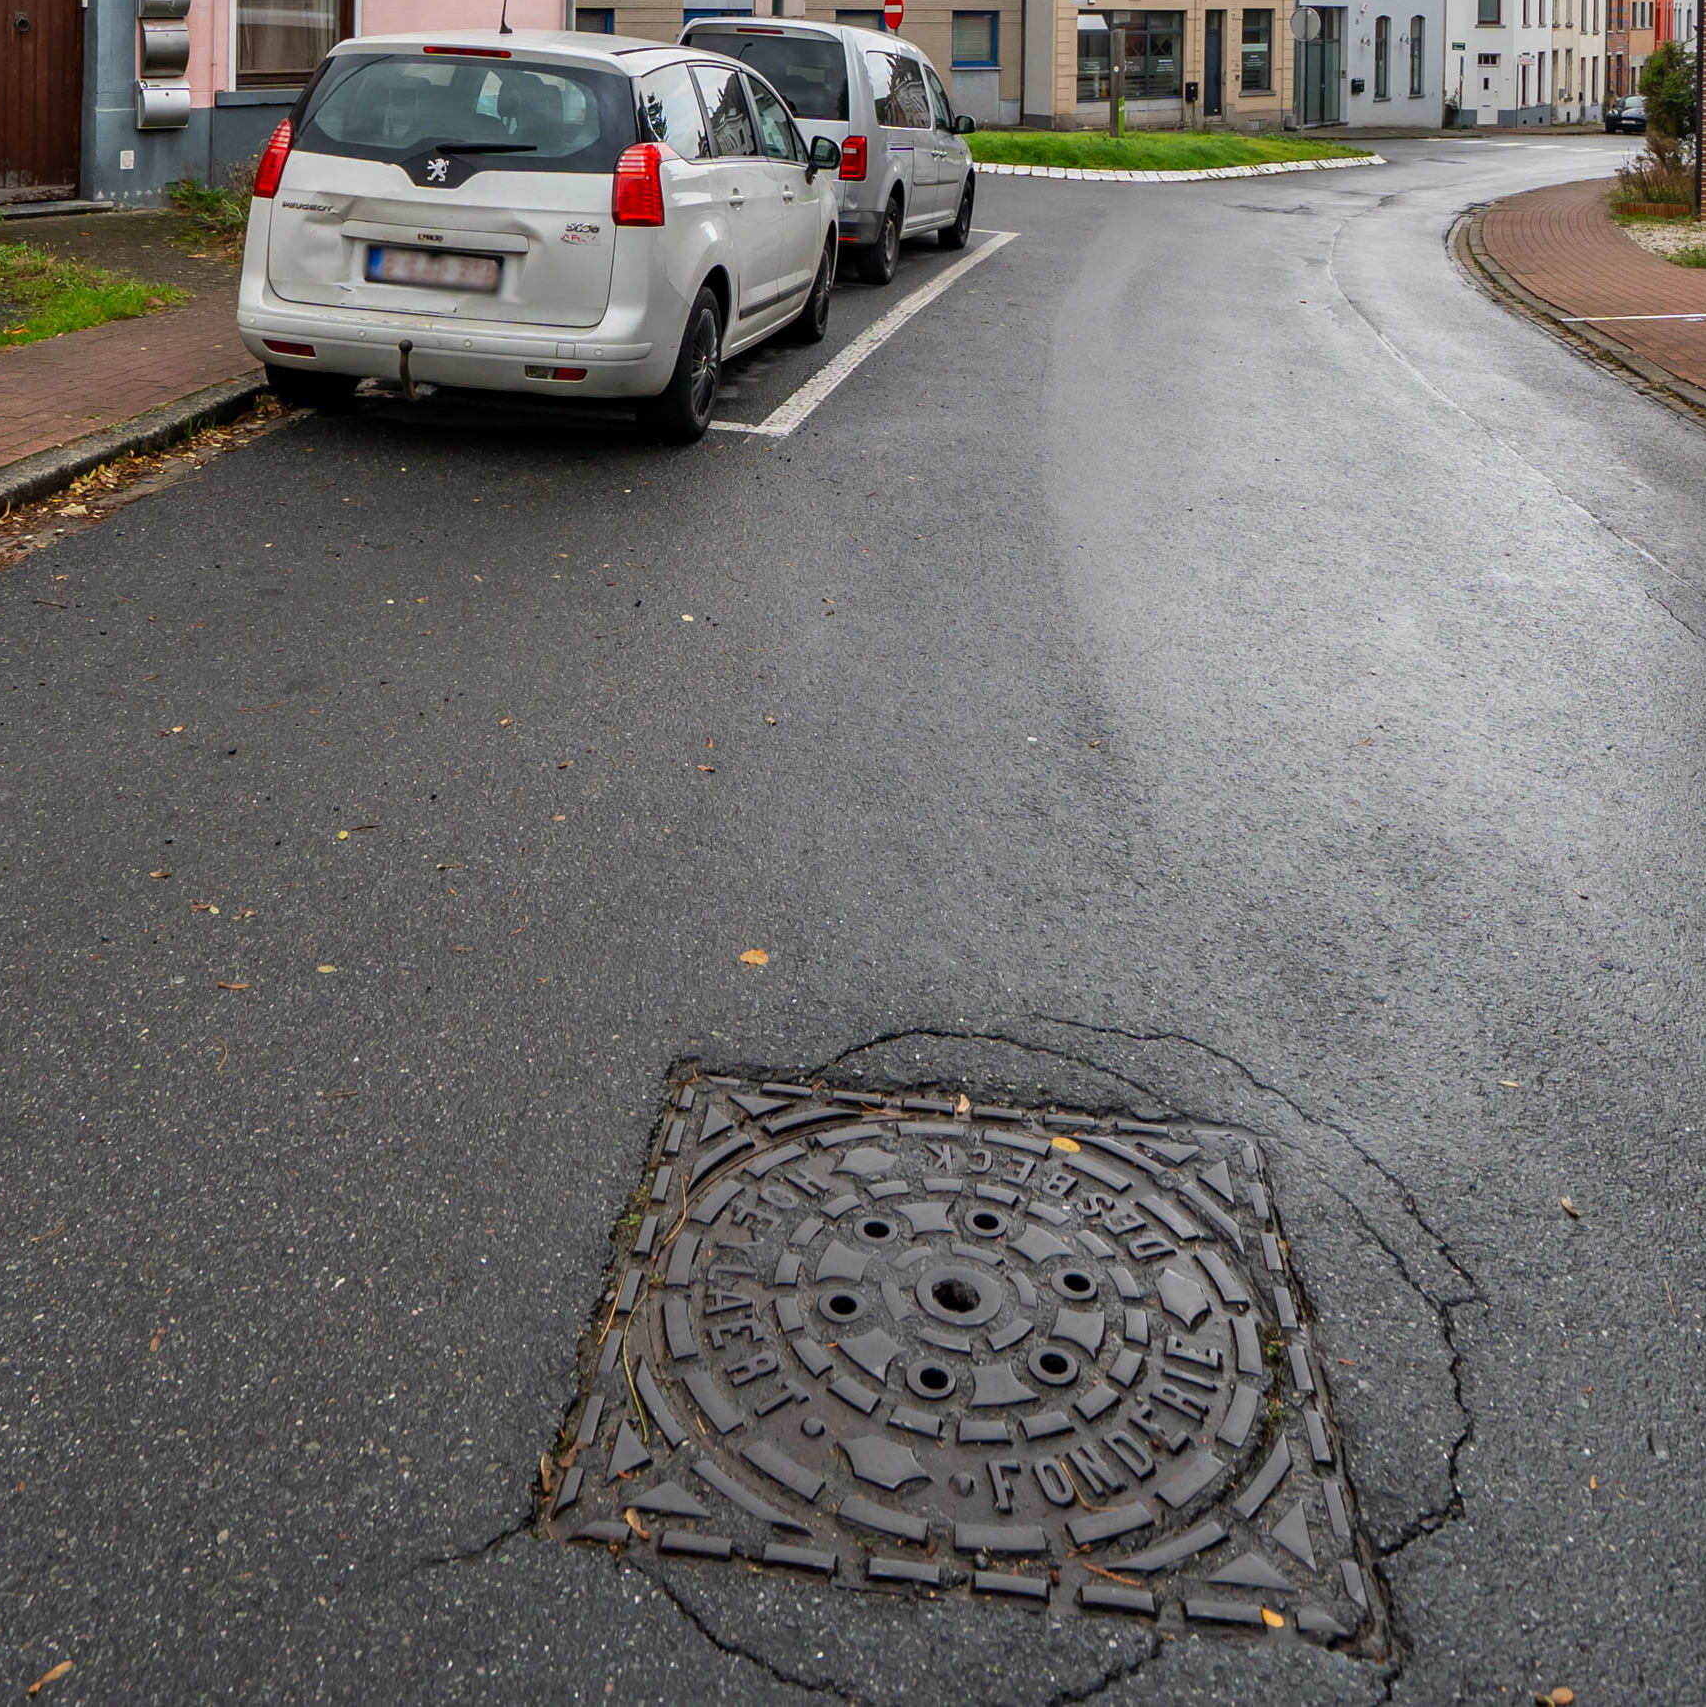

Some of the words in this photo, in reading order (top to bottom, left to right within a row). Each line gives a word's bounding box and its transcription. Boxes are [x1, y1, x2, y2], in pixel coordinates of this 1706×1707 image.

[282, 201, 334, 212] PEUGEOT
[925, 1143, 1179, 1261] DESBECK
[987, 1334, 1224, 1515] FONDERIE
